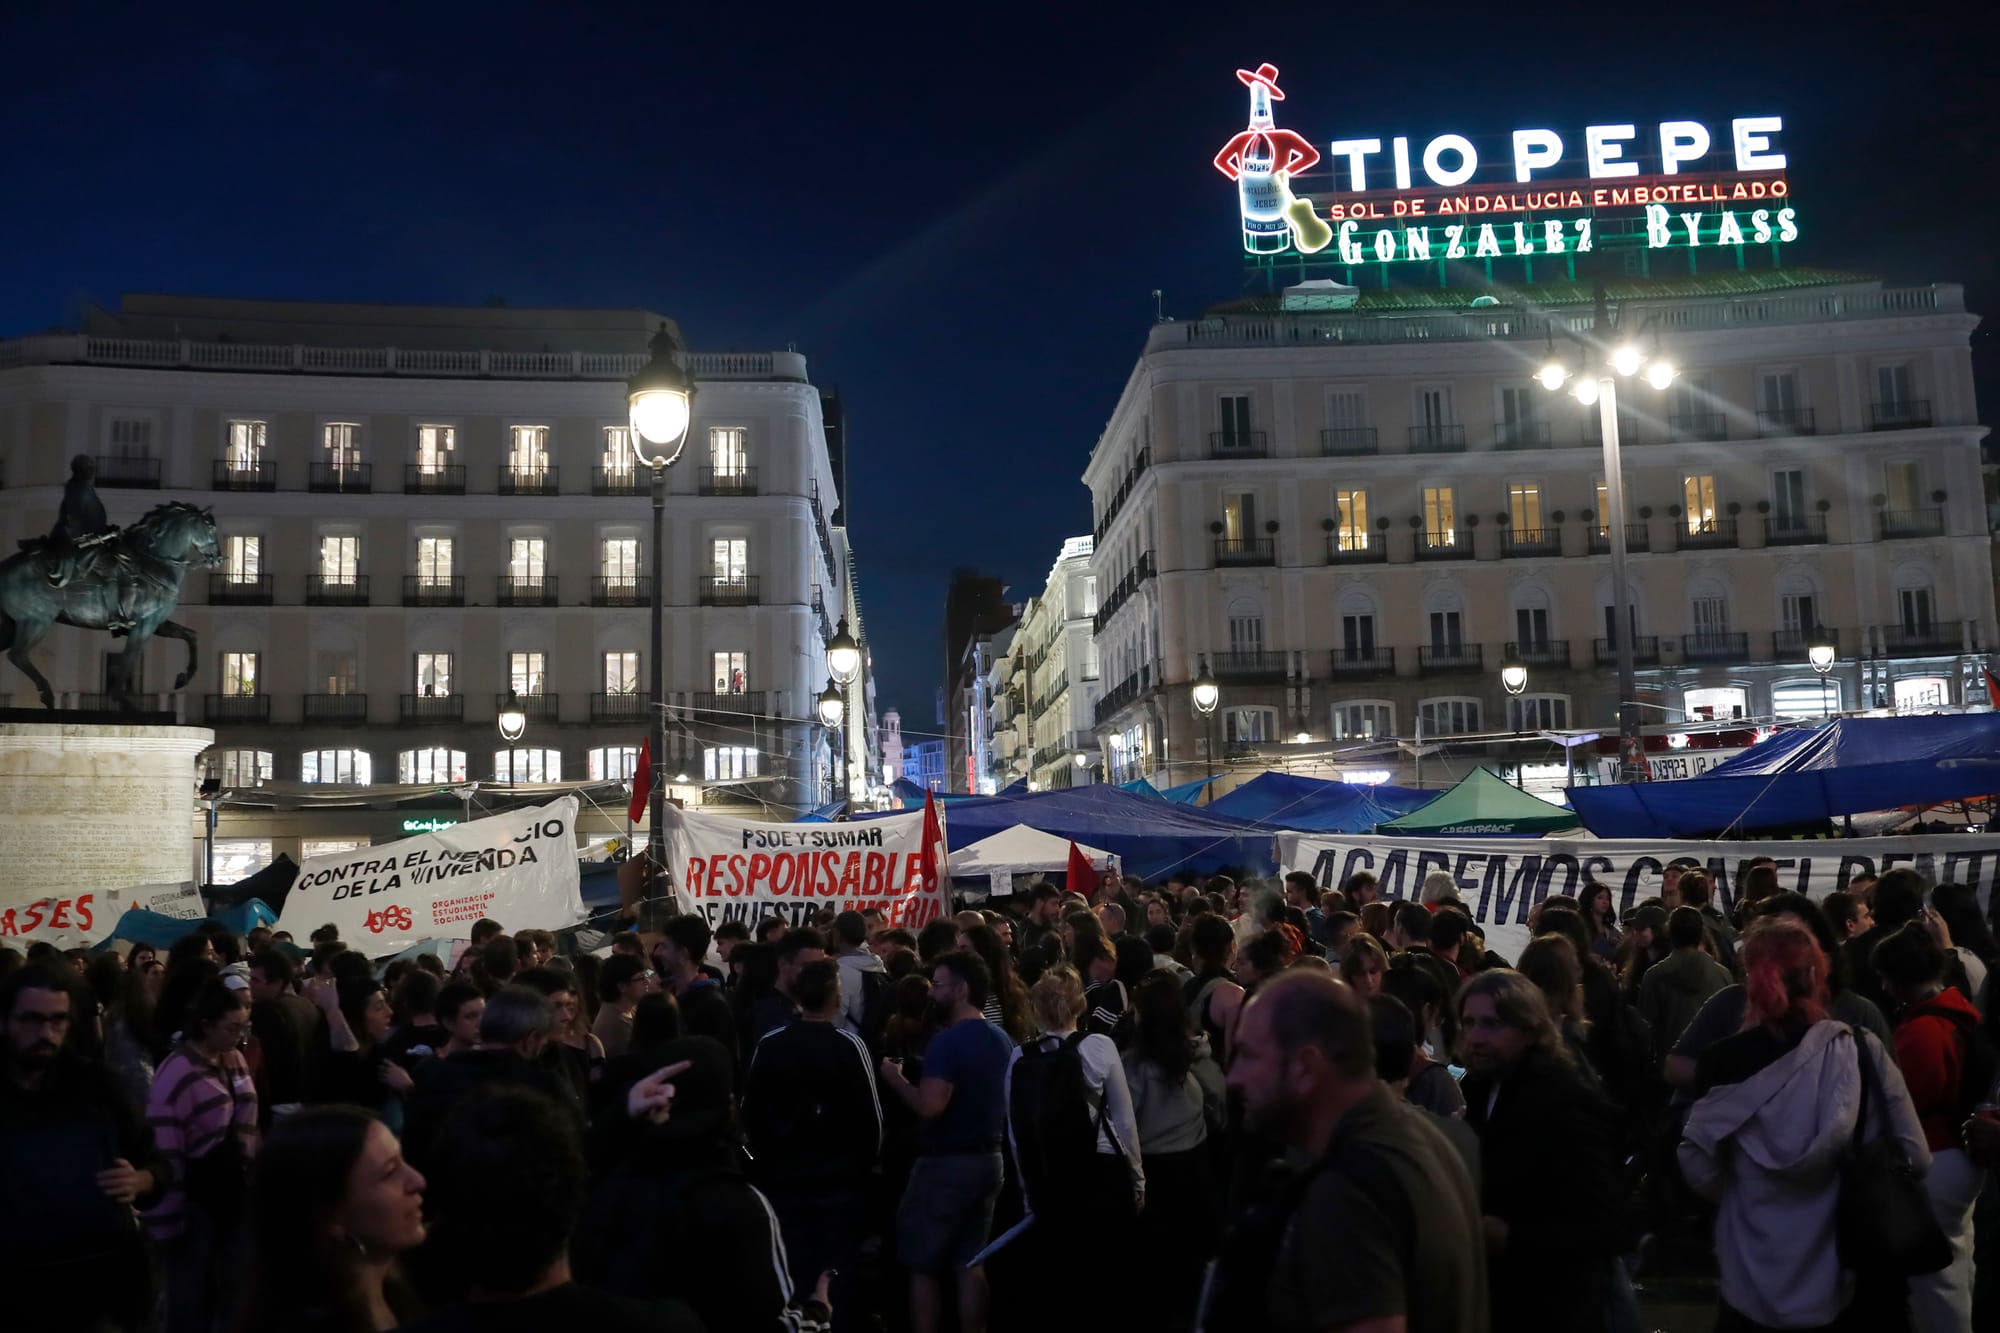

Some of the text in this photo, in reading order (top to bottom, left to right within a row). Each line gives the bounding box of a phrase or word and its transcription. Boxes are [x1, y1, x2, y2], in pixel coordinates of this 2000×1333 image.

[1331, 117, 1787, 191] TIO PEPE
[1254, 199, 1278, 208] JEREZ
[1331, 180, 1788, 220] SOL DE ANDALUCIA EMBOTELLADO
[1645, 204, 1798, 249] BYASS
[742, 827, 883, 850] PSOE Y SUMAR
[298, 856, 397, 891] CONTRA
[402, 850, 432, 869] EL
[332, 845, 538, 901] DE LA VIVIENDA
[431, 891, 495, 910] ORGANIZACIÓN
[432, 902, 489, 918] ESTUDIANTIL
[433, 910, 485, 926] SOCIALISTA
